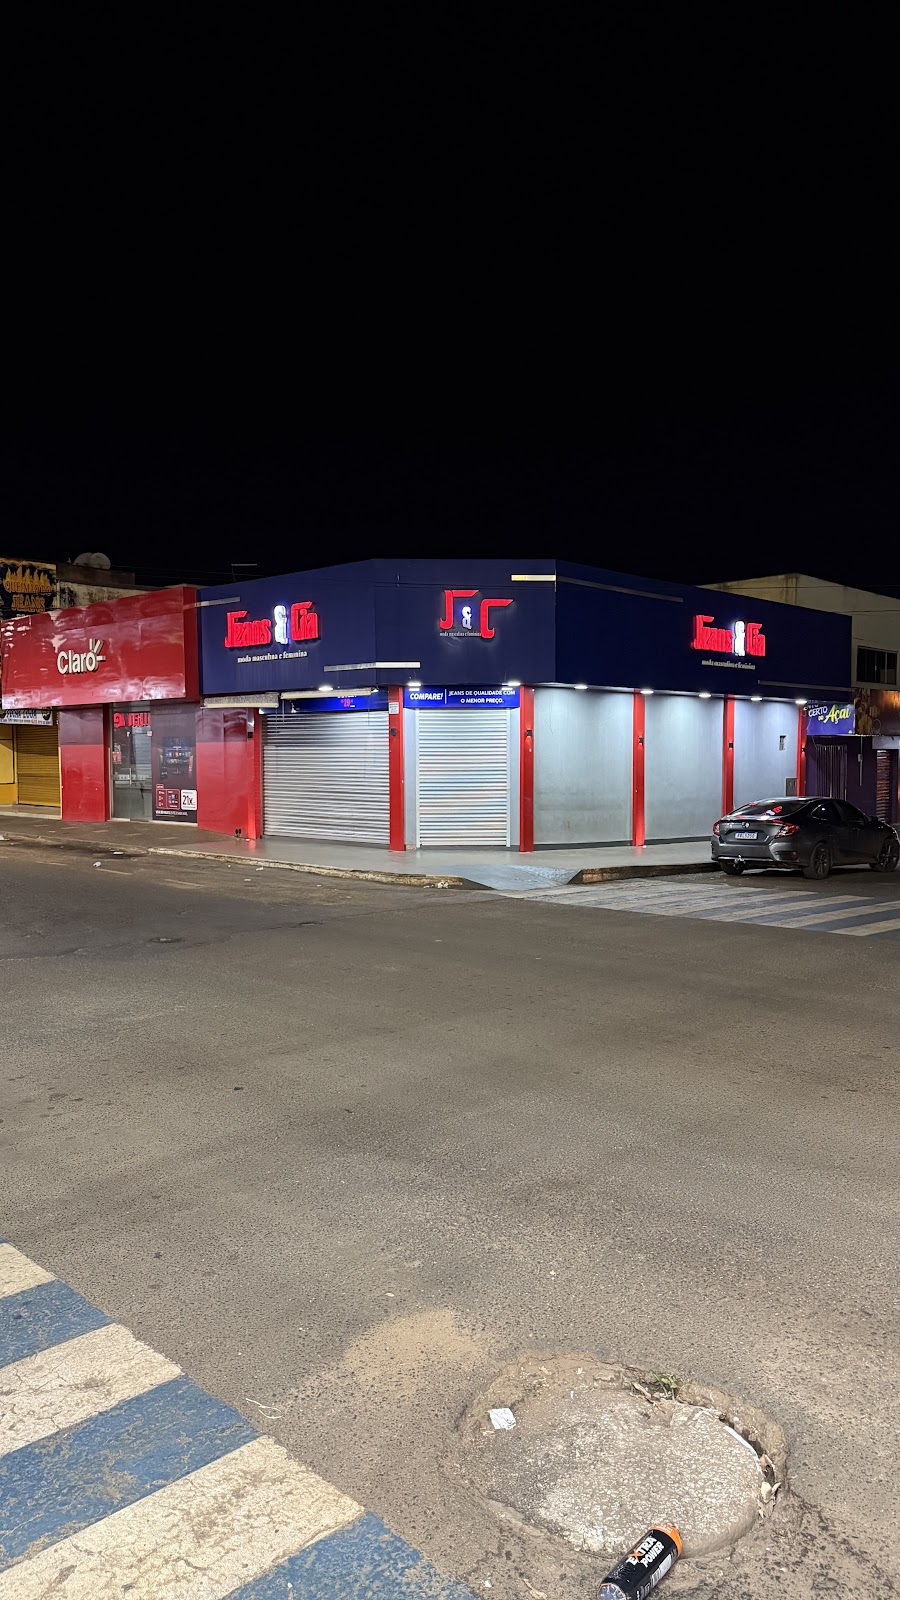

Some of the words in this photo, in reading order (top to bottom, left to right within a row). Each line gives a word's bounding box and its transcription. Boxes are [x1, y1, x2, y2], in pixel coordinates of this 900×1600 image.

[12, 595, 45, 612] JEANS
[224, 610, 272, 648] Jeans
[274, 605, 289, 644] &
[290, 601, 319, 641] Cia
[694, 614, 733, 653] Jeans
[734, 620, 746, 657] &
[57, 648, 98, 674] Claro
[237, 655, 252, 663] moda
[409, 692, 443, 700] COMPARE!
[808, 706, 828, 717] CERTO
[626, 1536, 658, 1566] EXTRA
[640, 1541, 665, 1568] POWER
